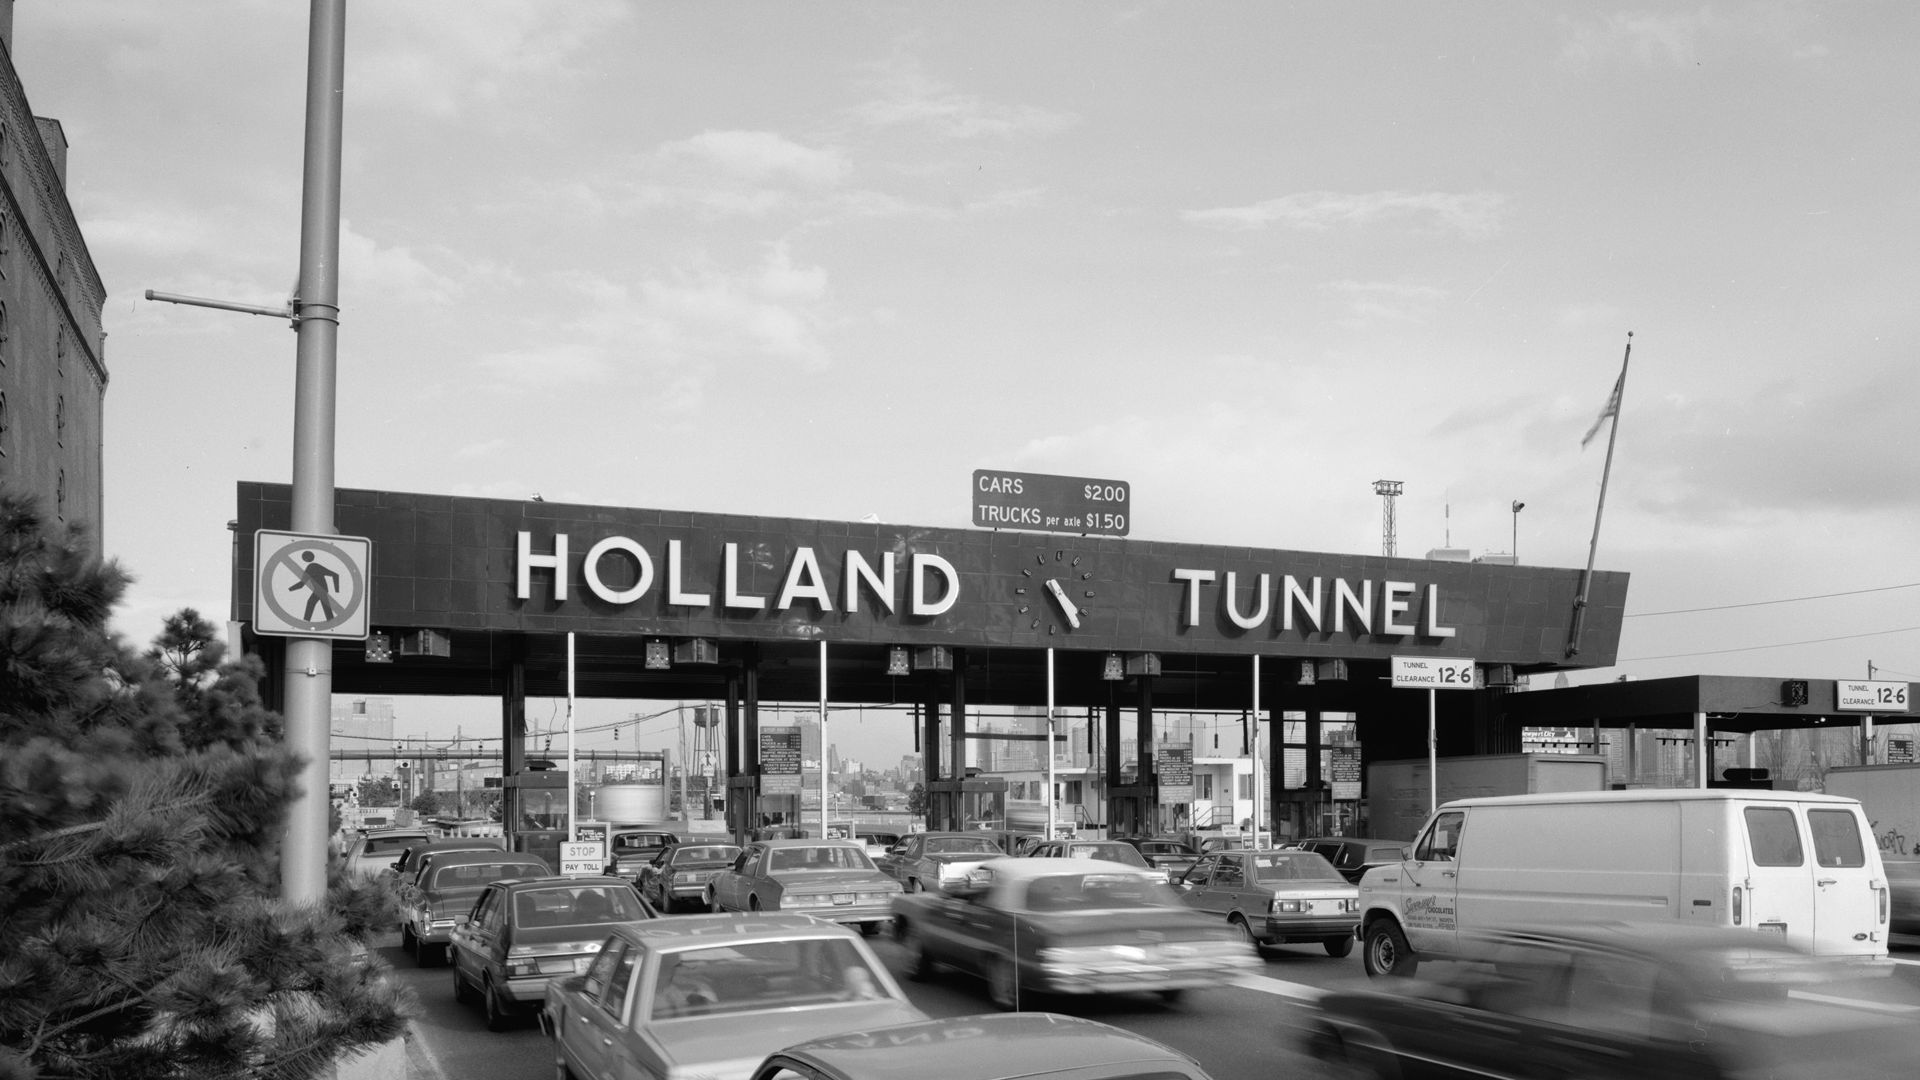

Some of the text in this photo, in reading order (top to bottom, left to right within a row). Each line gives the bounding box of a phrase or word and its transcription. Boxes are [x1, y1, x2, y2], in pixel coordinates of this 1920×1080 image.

[979, 475, 1125, 502] CARS $2.00
[978, 504, 1125, 530] TRUCKS per axle $1.50
[516, 530, 960, 616] HOLLAND
[1174, 568, 1456, 638] TUNNEL
[1403, 661, 1428, 669] TUNNEL
[1396, 674, 1435, 683] CLEARANCE
[1842, 697, 1875, 705] CLEARANCE
[1522, 730, 1543, 738] ewport
[570, 847, 595, 857] STOP
